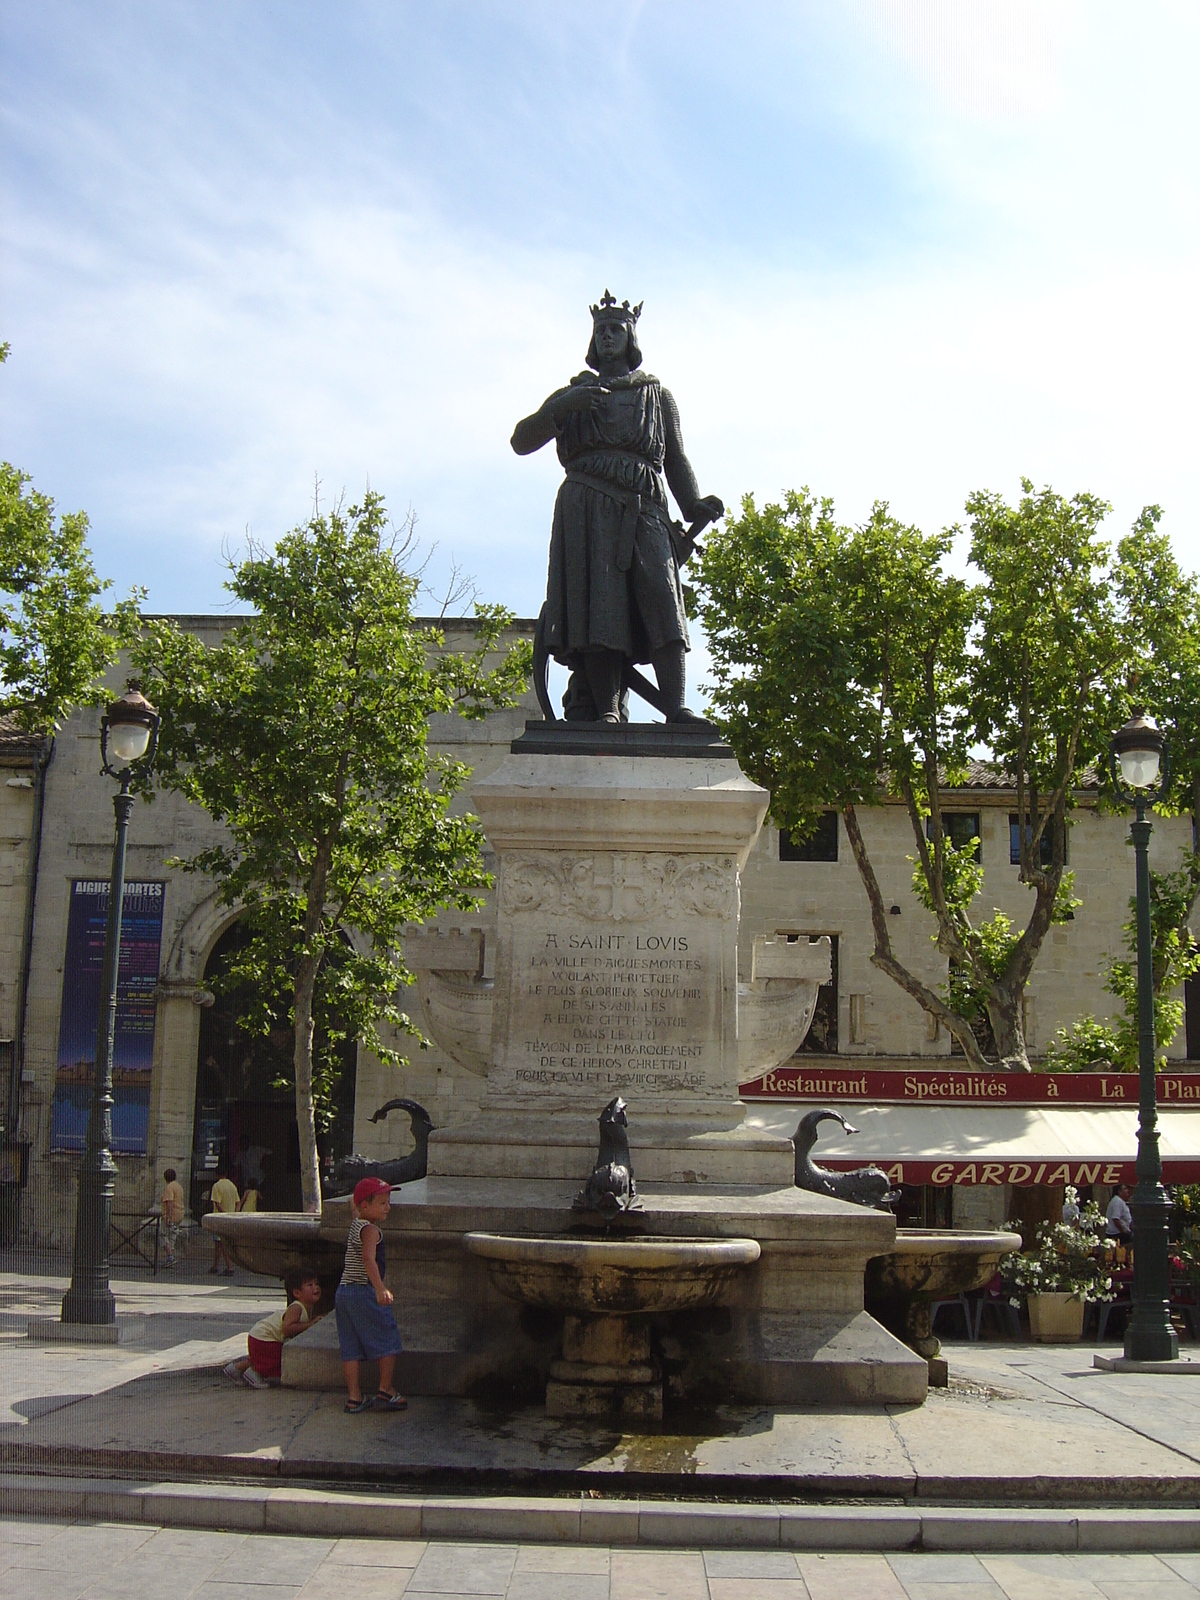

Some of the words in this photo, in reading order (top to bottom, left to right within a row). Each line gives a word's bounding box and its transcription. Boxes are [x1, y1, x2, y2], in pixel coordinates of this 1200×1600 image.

[545, 933, 558, 948] A
[569, 934, 626, 949] SAINT
[636, 936, 689, 951] LOVIS
[531, 956, 548, 967] LA
[555, 957, 588, 967] VILLE
[552, 971, 608, 982] VOULANT
[528, 985, 543, 995] LE
[547, 986, 576, 996] PLUS
[581, 986, 638, 997] GLORIEUX
[643, 988, 702, 999] SOUVENIR
[562, 1000, 579, 1010] DE
[645, 1016, 688, 1027] STATUE
[573, 1028, 606, 1039] DANS
[611, 1030, 626, 1040] LE
[575, 1043, 591, 1054] DE
[541, 1056, 556, 1067] DE
[562, 1057, 578, 1068] CE
[516, 1069, 548, 1082] POUR
[760, 1073, 868, 1094] Restaurant
[904, 1076, 1008, 1099] Spécialités
[1047, 1078, 1060, 1097] à
[1100, 1079, 1125, 1098] La
[931, 1163, 1124, 1184] GARDIANE
